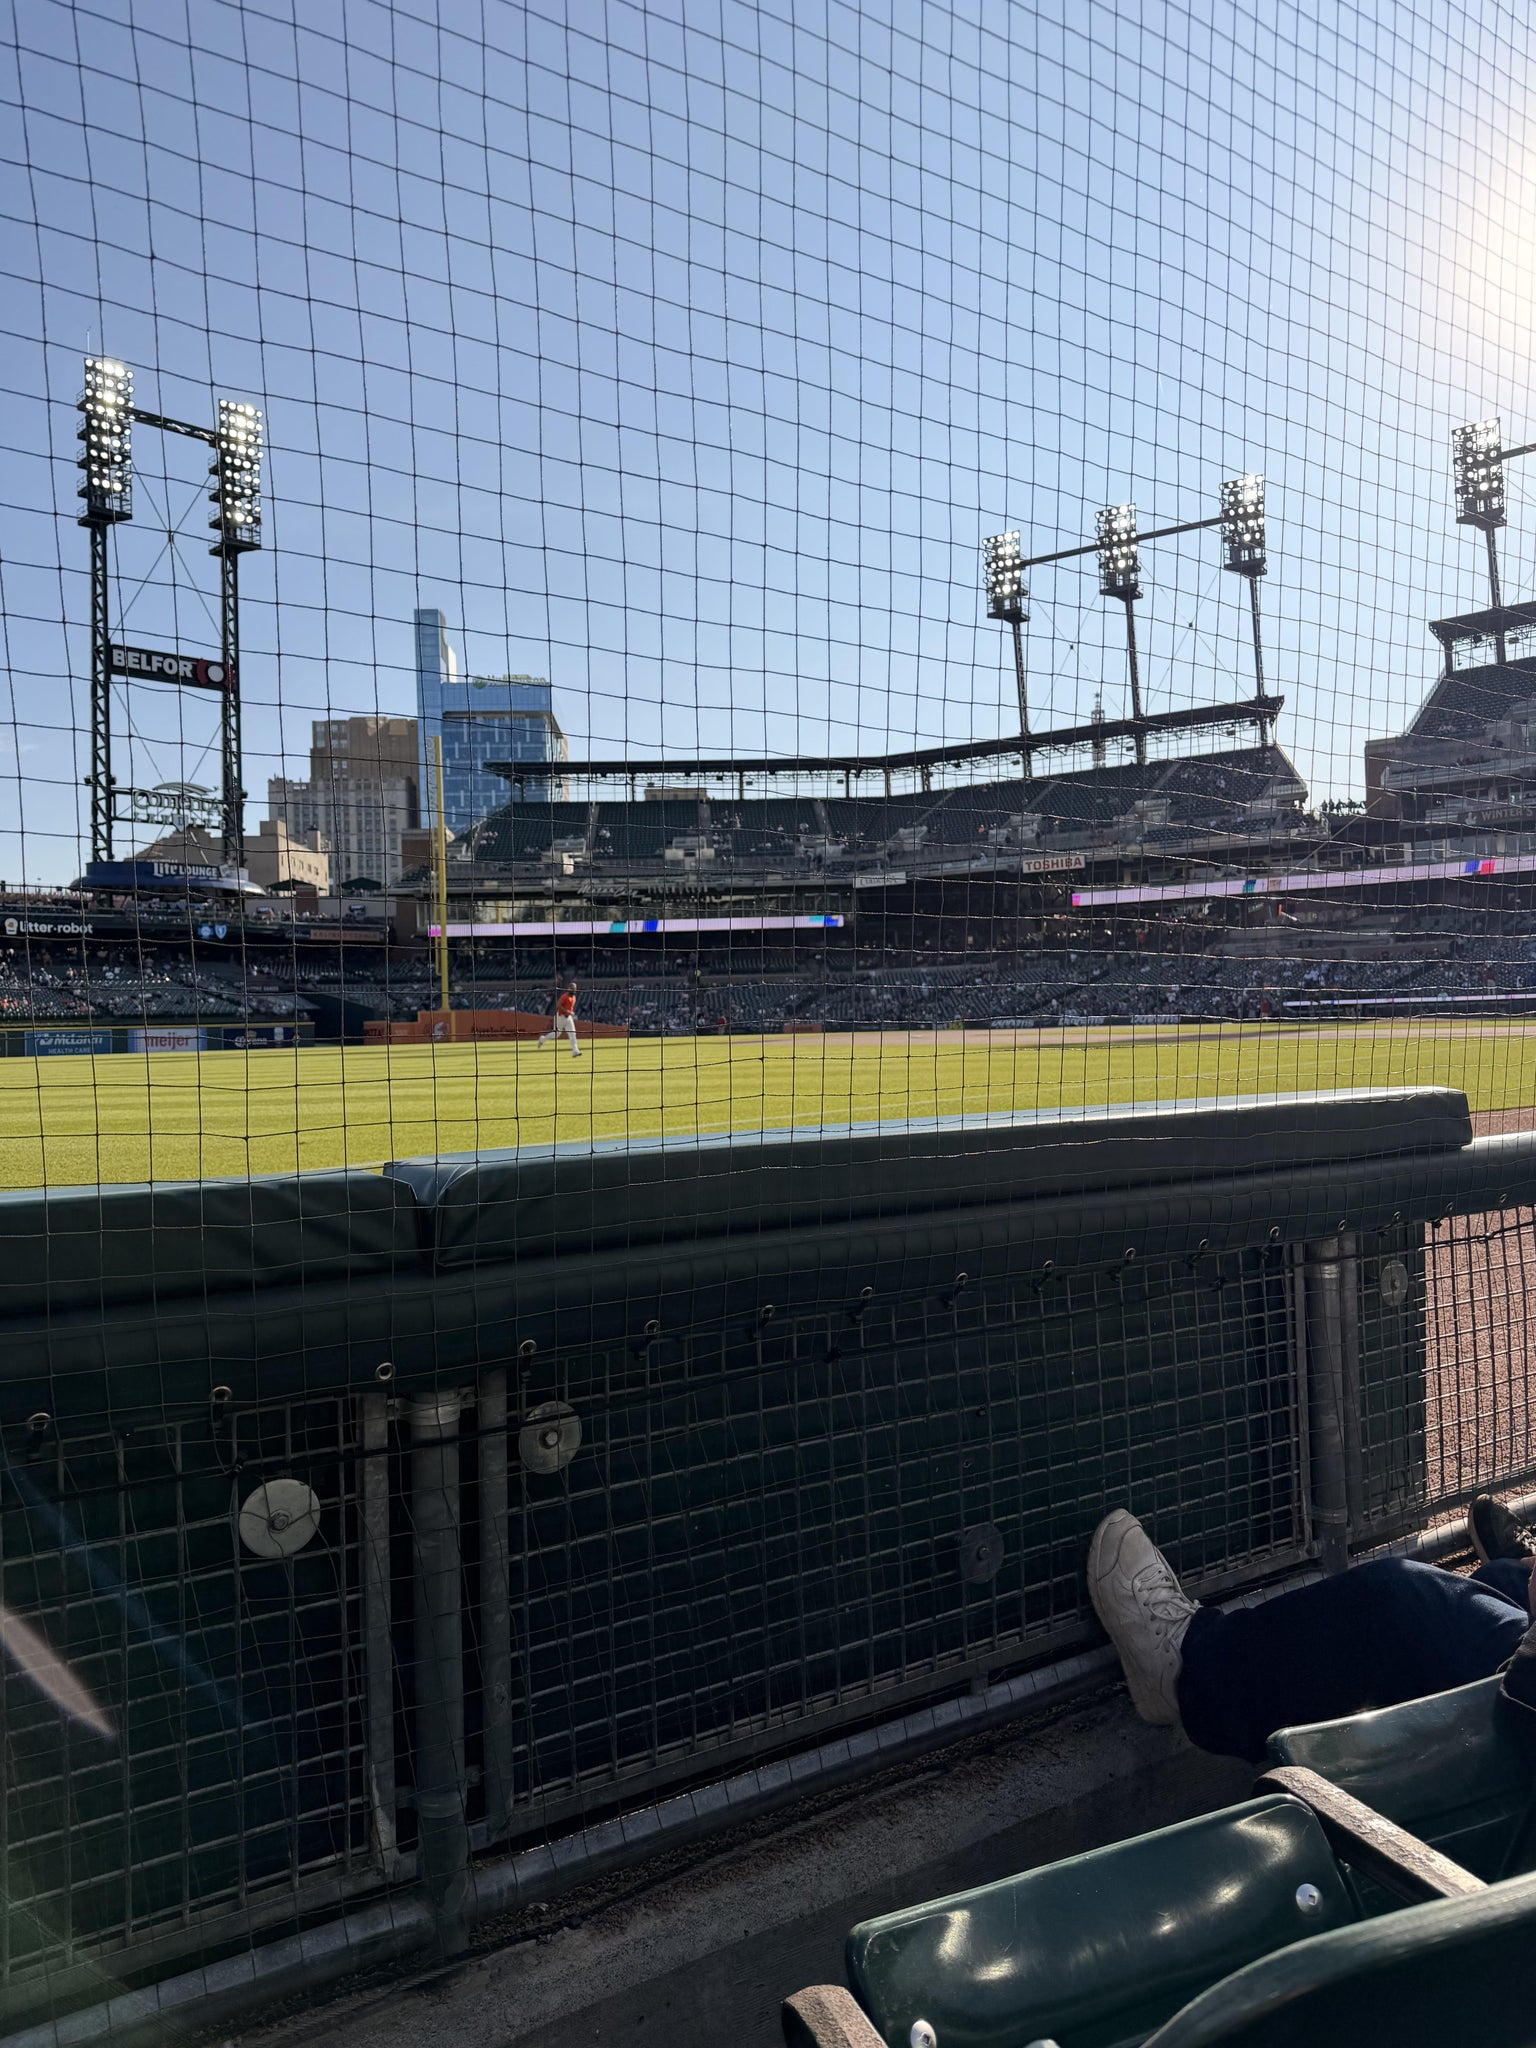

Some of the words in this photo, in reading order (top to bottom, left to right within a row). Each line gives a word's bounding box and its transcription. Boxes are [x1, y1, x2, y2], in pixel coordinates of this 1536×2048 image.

[112, 648, 194, 678] BELFOR
[153, 862, 178, 877] Lite
[179, 866, 218, 877] LOUNGE
[1025, 857, 1082, 871] TOSHIBA
[146, 1032, 189, 1049] meijer
[49, 1047, 74, 1055] HEALTH
